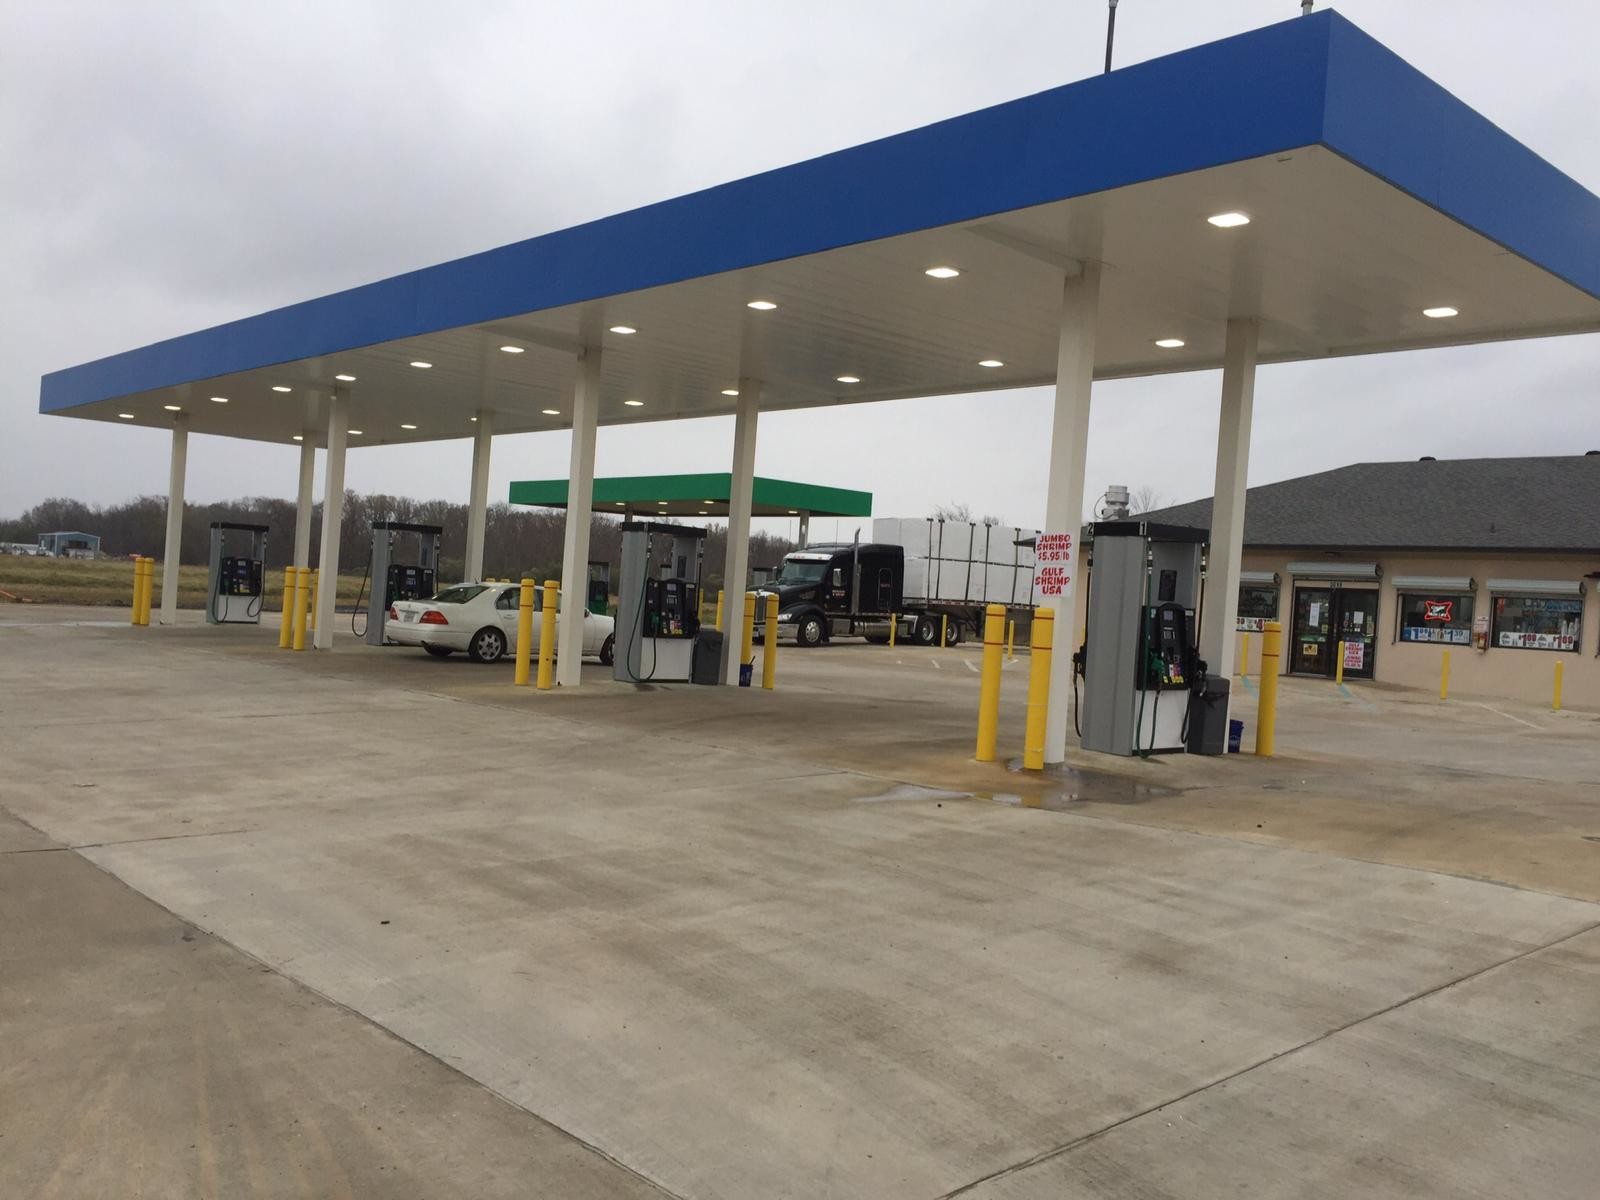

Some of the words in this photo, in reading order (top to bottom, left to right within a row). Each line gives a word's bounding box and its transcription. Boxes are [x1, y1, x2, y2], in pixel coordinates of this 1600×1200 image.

[1040, 534, 1071, 543] JUMBO
[1036, 542, 1072, 551] SHRIMP
[1038, 551, 1060, 561] $5.95
[1041, 567, 1065, 577] GULF
[1035, 576, 1070, 586] SHRIMP
[1042, 585, 1062, 595] USA
